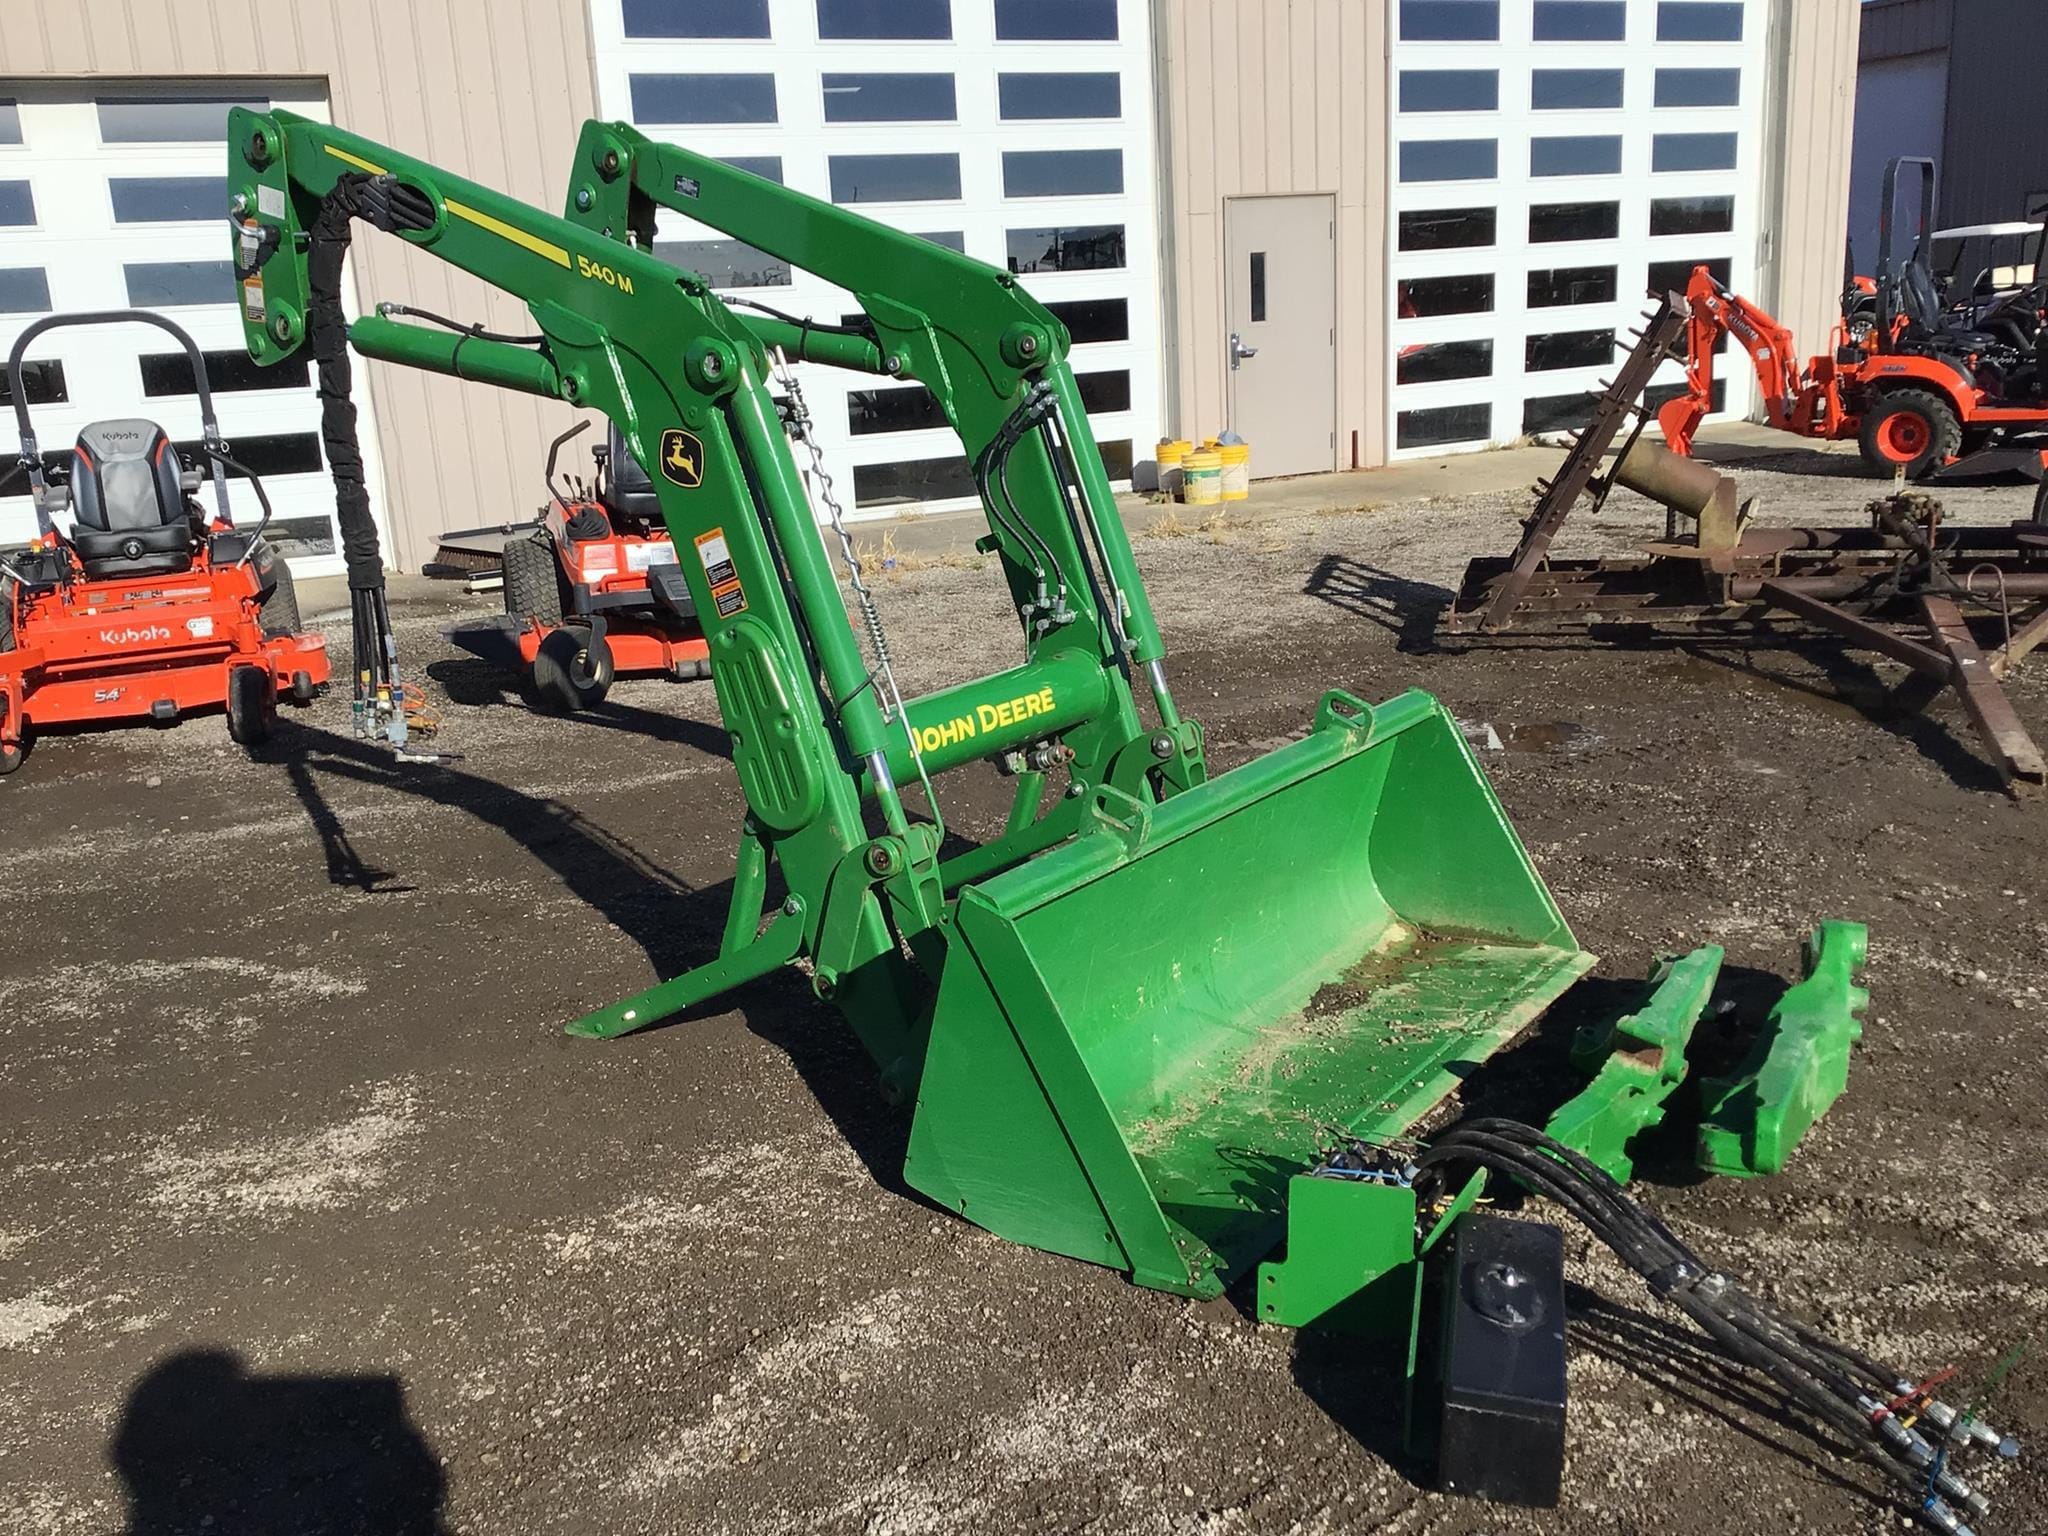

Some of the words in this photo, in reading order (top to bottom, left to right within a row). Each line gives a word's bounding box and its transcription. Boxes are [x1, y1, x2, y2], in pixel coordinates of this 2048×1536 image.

[576, 254, 615, 286] 540
[617, 272, 634, 295] M
[1728, 313, 1759, 341] KUBOTA
[102, 431, 139, 441] Kubota
[100, 625, 171, 644] Kubota
[909, 715, 976, 758] JOHN
[976, 687, 1056, 733] DEERE
